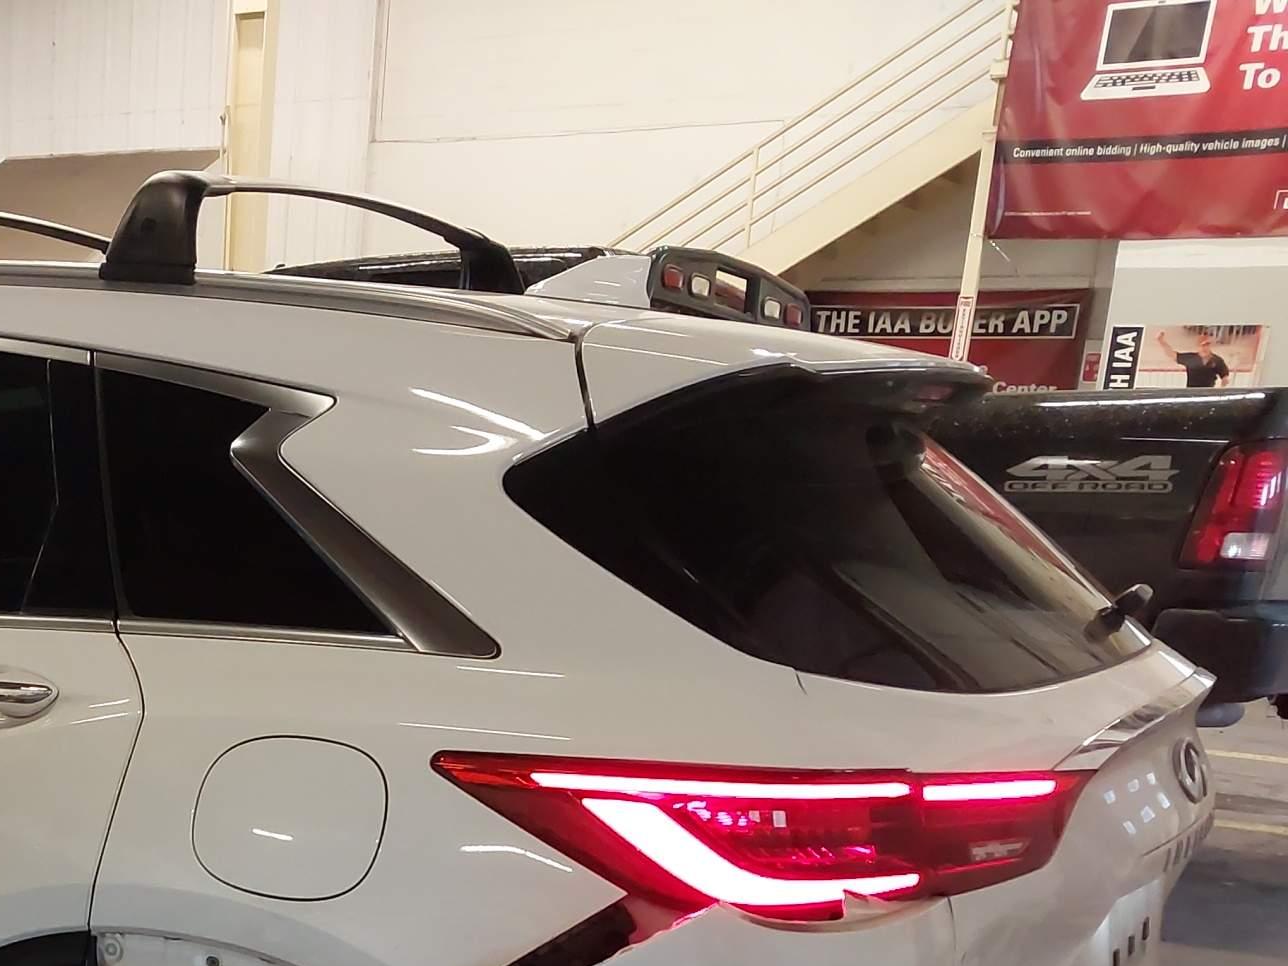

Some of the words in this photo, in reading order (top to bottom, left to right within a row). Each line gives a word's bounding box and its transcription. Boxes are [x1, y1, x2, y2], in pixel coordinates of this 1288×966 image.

[1239, 62, 1281, 90] To
[1013, 147, 1064, 158] Convenient
[1065, 145, 1095, 156] online
[1096, 144, 1132, 156] bidding
[1139, 141, 1200, 155] High-quality
[1202, 138, 1239, 151] vehicle
[1241, 137, 1280, 150] images
[816, 310, 861, 333] THE
[867, 311, 911, 333] IAA
[919, 310, 1005, 334] BUER
[1011, 309, 1068, 333] APP
[1112, 331, 1138, 368] IAA
[993, 381, 1058, 395] Center
